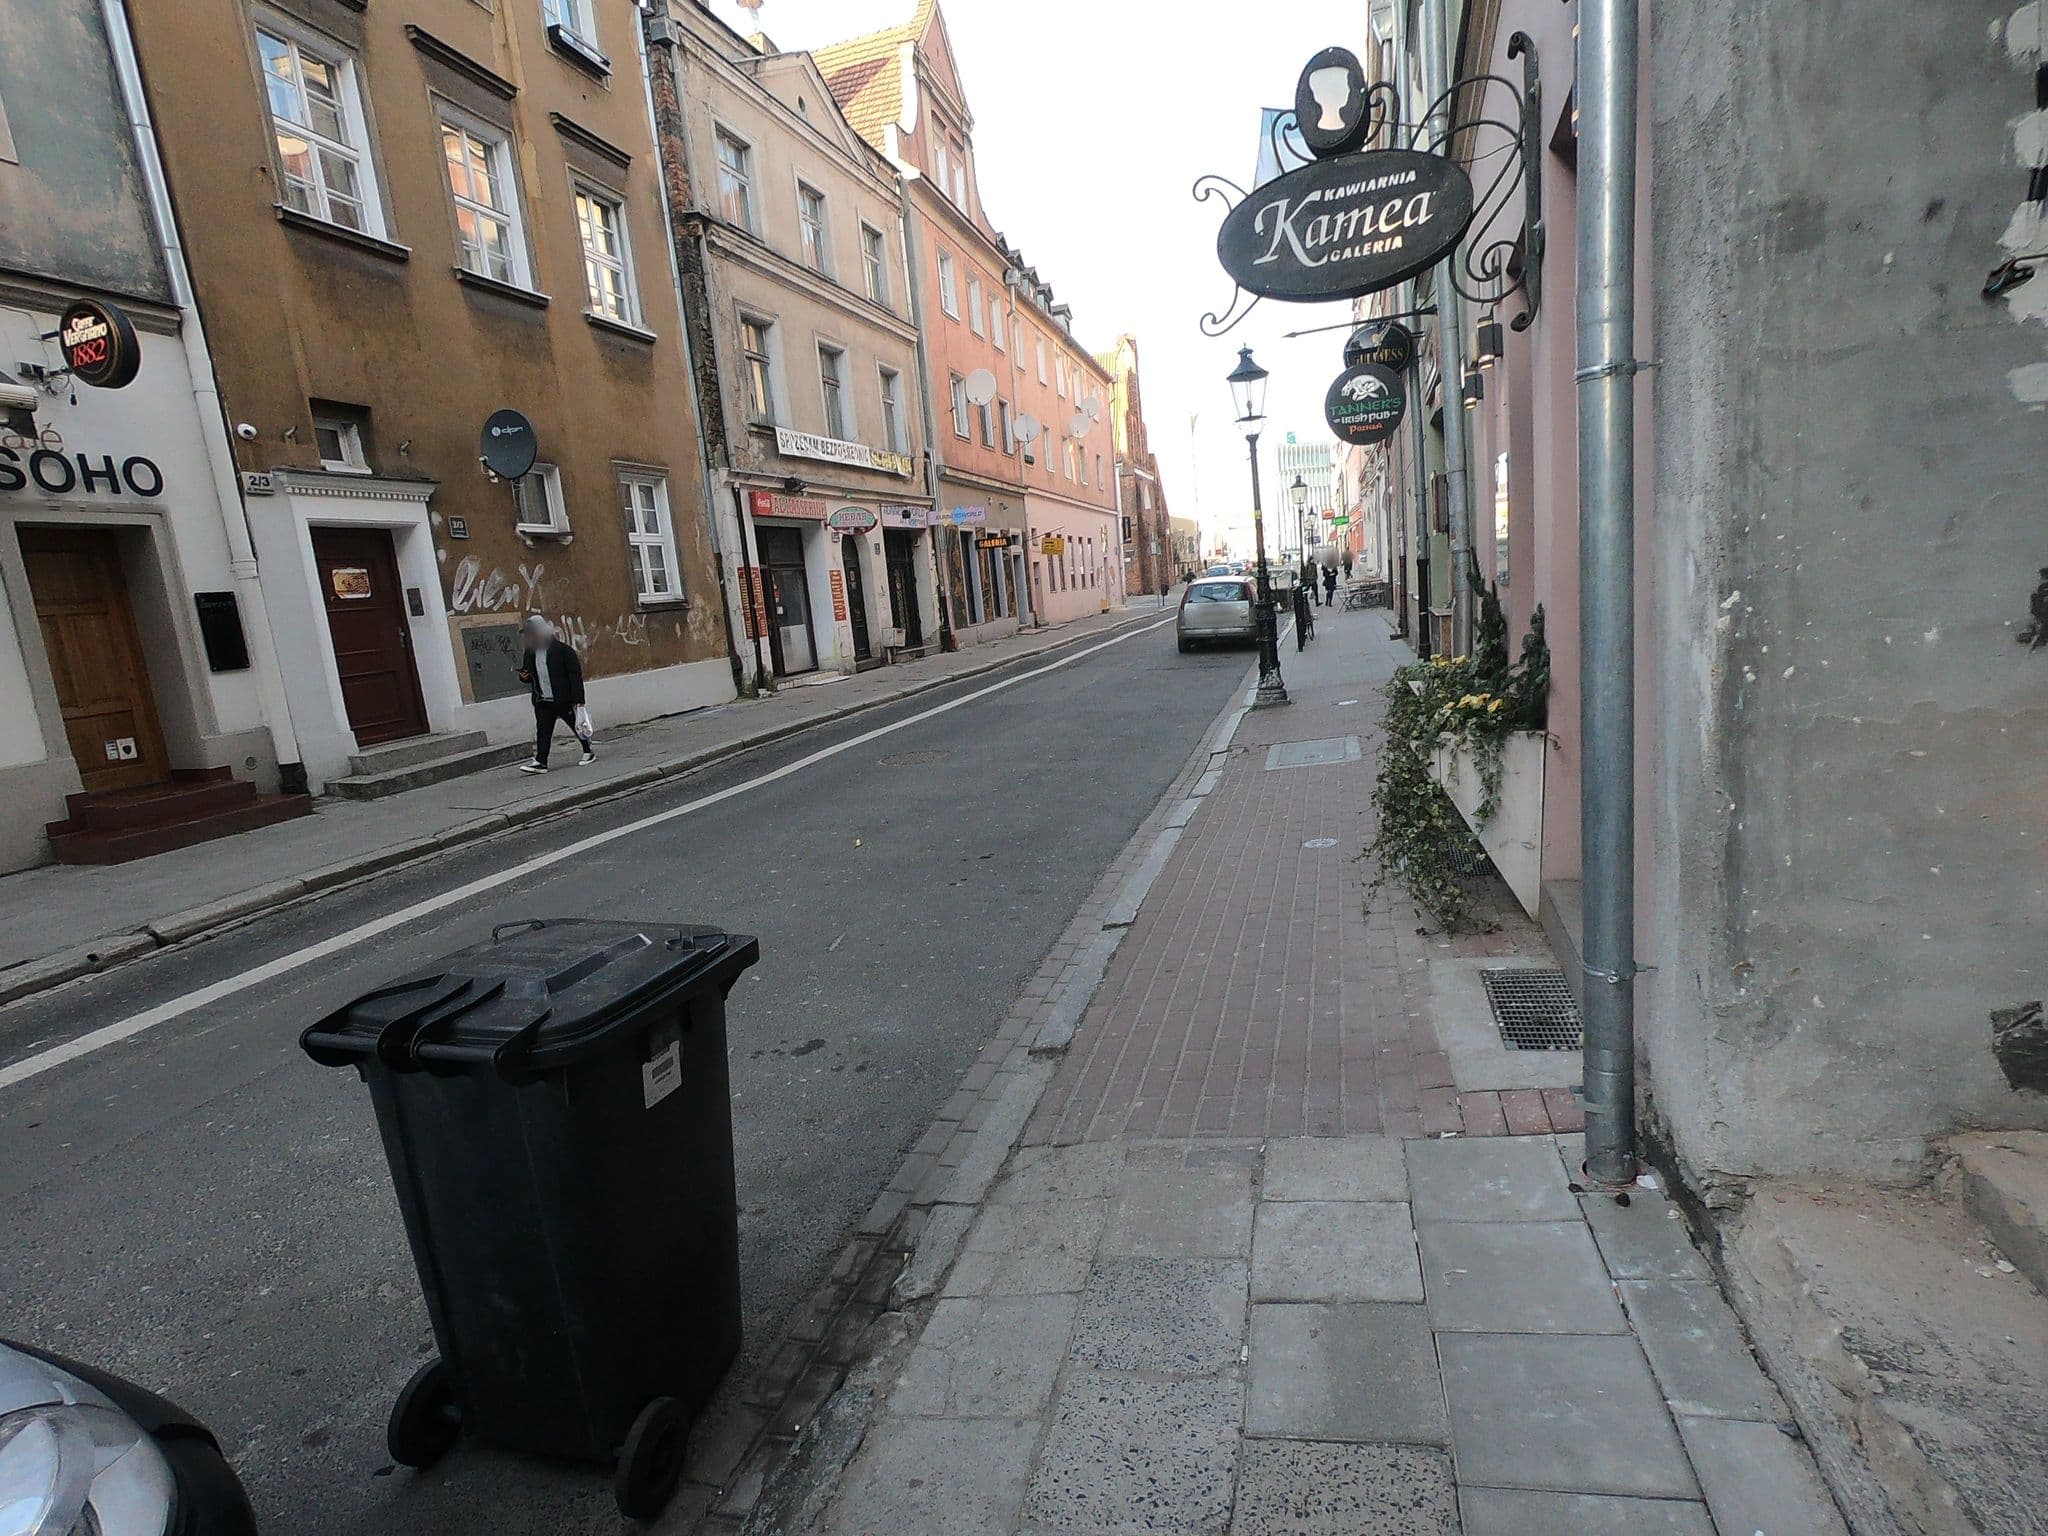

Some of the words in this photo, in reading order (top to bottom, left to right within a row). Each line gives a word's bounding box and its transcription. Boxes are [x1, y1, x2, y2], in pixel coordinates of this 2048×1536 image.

[1324, 170, 1417, 202] KAWIARNIA
[1253, 189, 1435, 267] Kamea
[1330, 236, 1403, 262] GALERIA
[73, 338, 106, 367] 1882
[0, 446, 164, 497] SOHO
